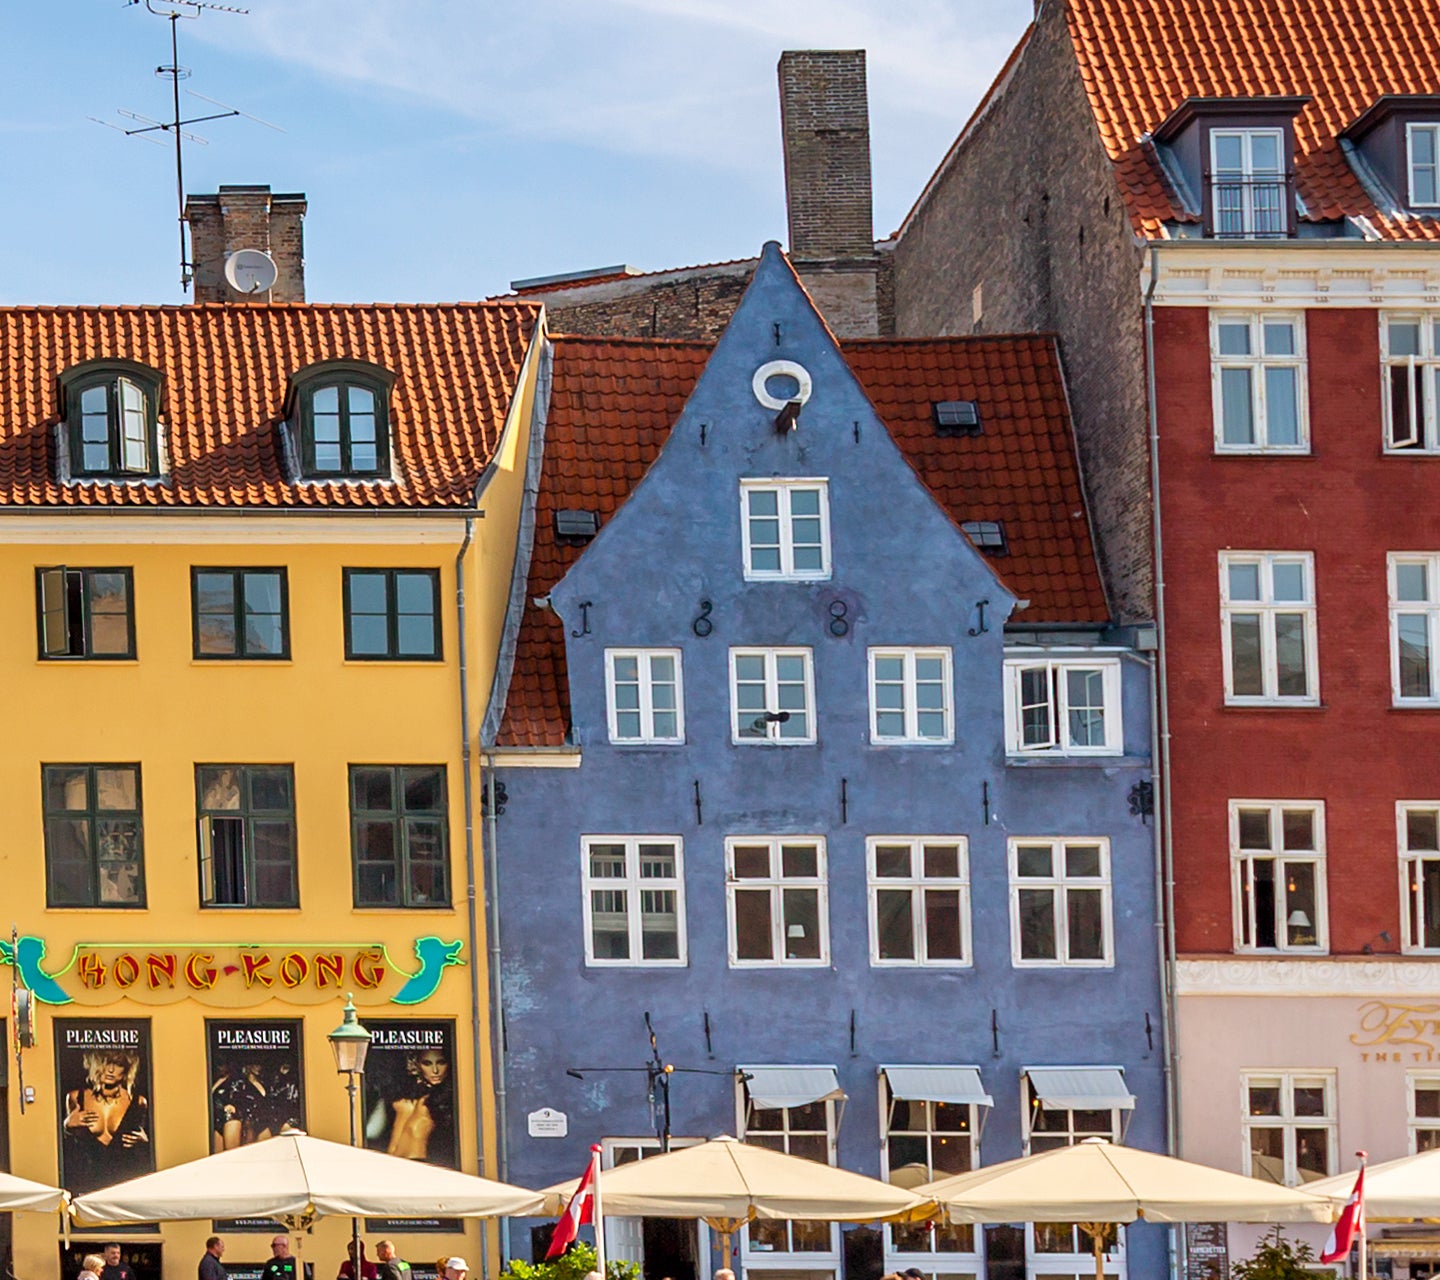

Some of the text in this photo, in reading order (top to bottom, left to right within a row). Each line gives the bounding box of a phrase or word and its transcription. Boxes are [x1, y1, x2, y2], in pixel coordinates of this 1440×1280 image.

[77, 951, 387, 992] HONG-KONG
[66, 1030, 139, 1043] PLEASURE
[218, 1030, 291, 1044] PLEASURE
[371, 1030, 444, 1044] PLEASURE
[1361, 1053, 1402, 1063] THE
